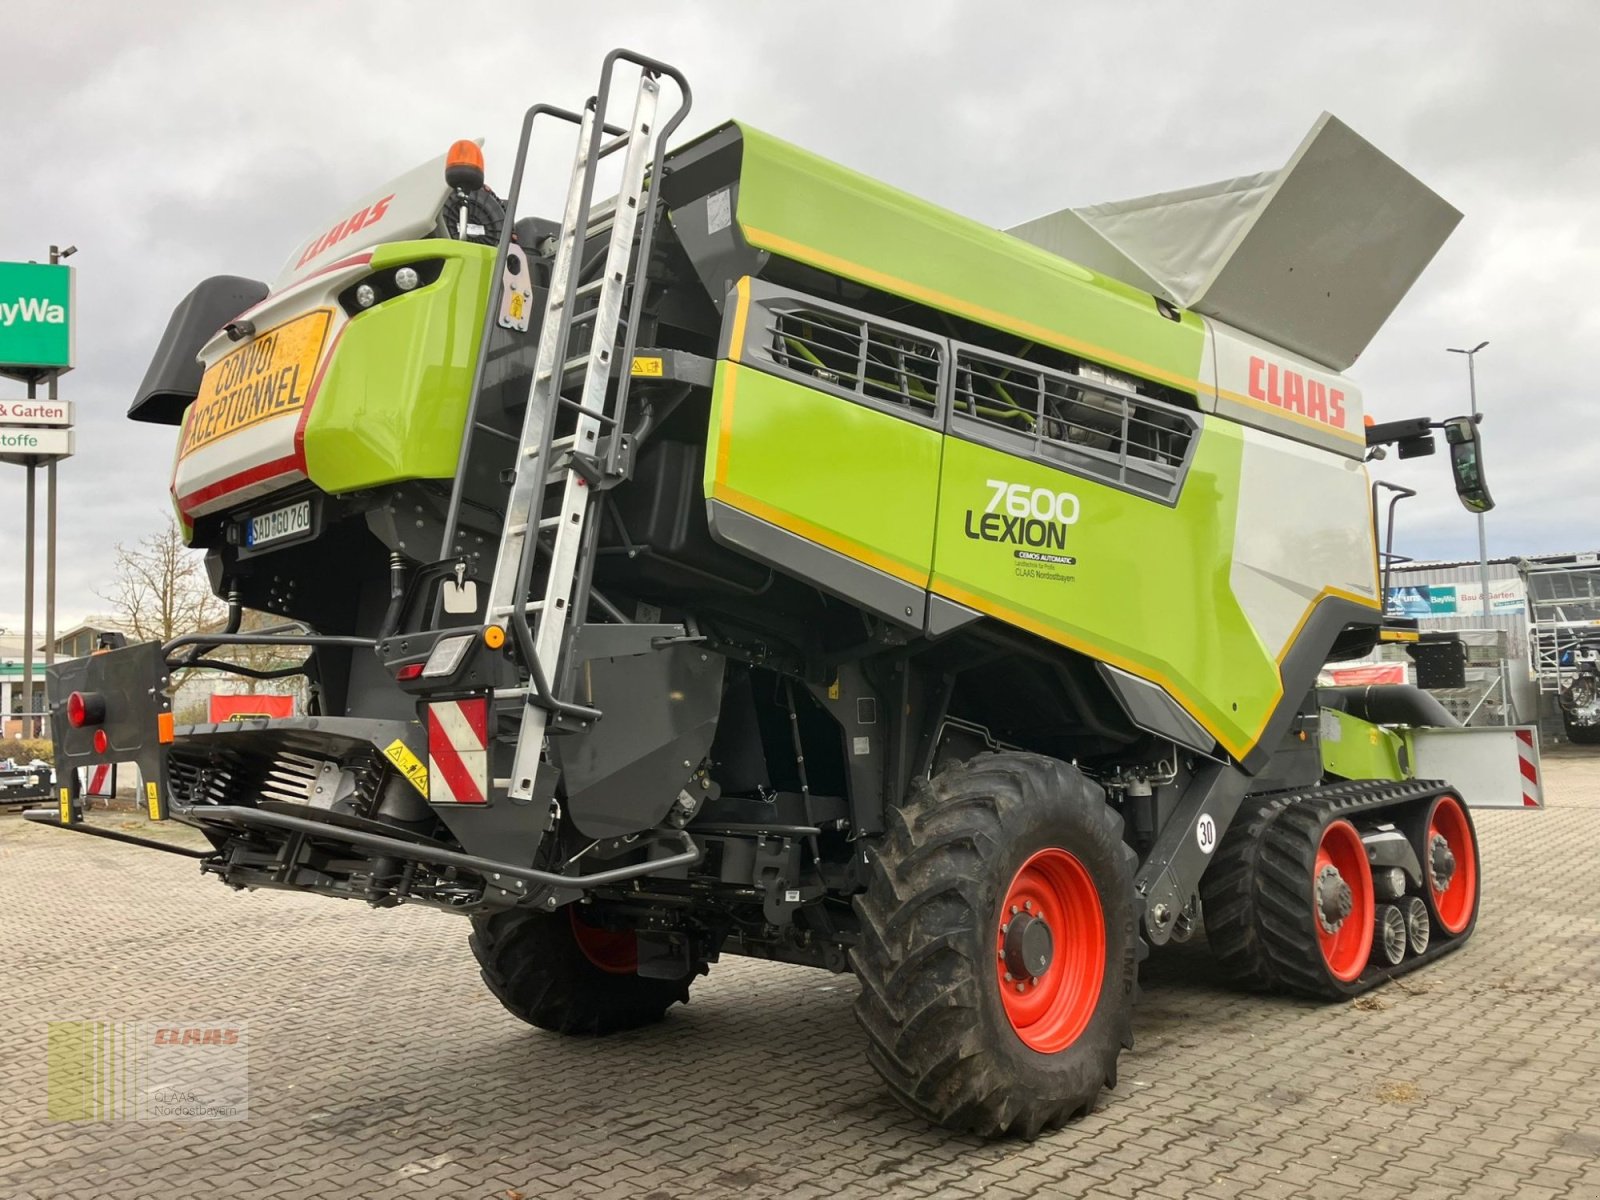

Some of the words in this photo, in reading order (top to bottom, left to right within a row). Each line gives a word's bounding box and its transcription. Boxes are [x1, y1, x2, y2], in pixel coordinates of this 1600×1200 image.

[295, 193, 396, 271] CLAAS
[0, 297, 64, 326] yWa
[215, 333, 279, 396] CONVOI
[1248, 356, 1345, 429] CLAAS
[12, 404, 63, 417] Garten
[0, 434, 38, 447] toffe
[984, 479, 1080, 524] 7600
[254, 516, 271, 541] SAD
[291, 504, 310, 531] 760
[965, 509, 1067, 550] LEXION
[1019, 551, 1040, 560] CEMOS
[1040, 555, 1073, 564] AUTOMATIC
[1015, 567, 1035, 578] CLAAS
[1036, 570, 1076, 583] Nordostbayern
[1431, 595, 1456, 604] BayWa
[1461, 593, 1477, 601] Bau
[1200, 821, 1212, 846] 30
